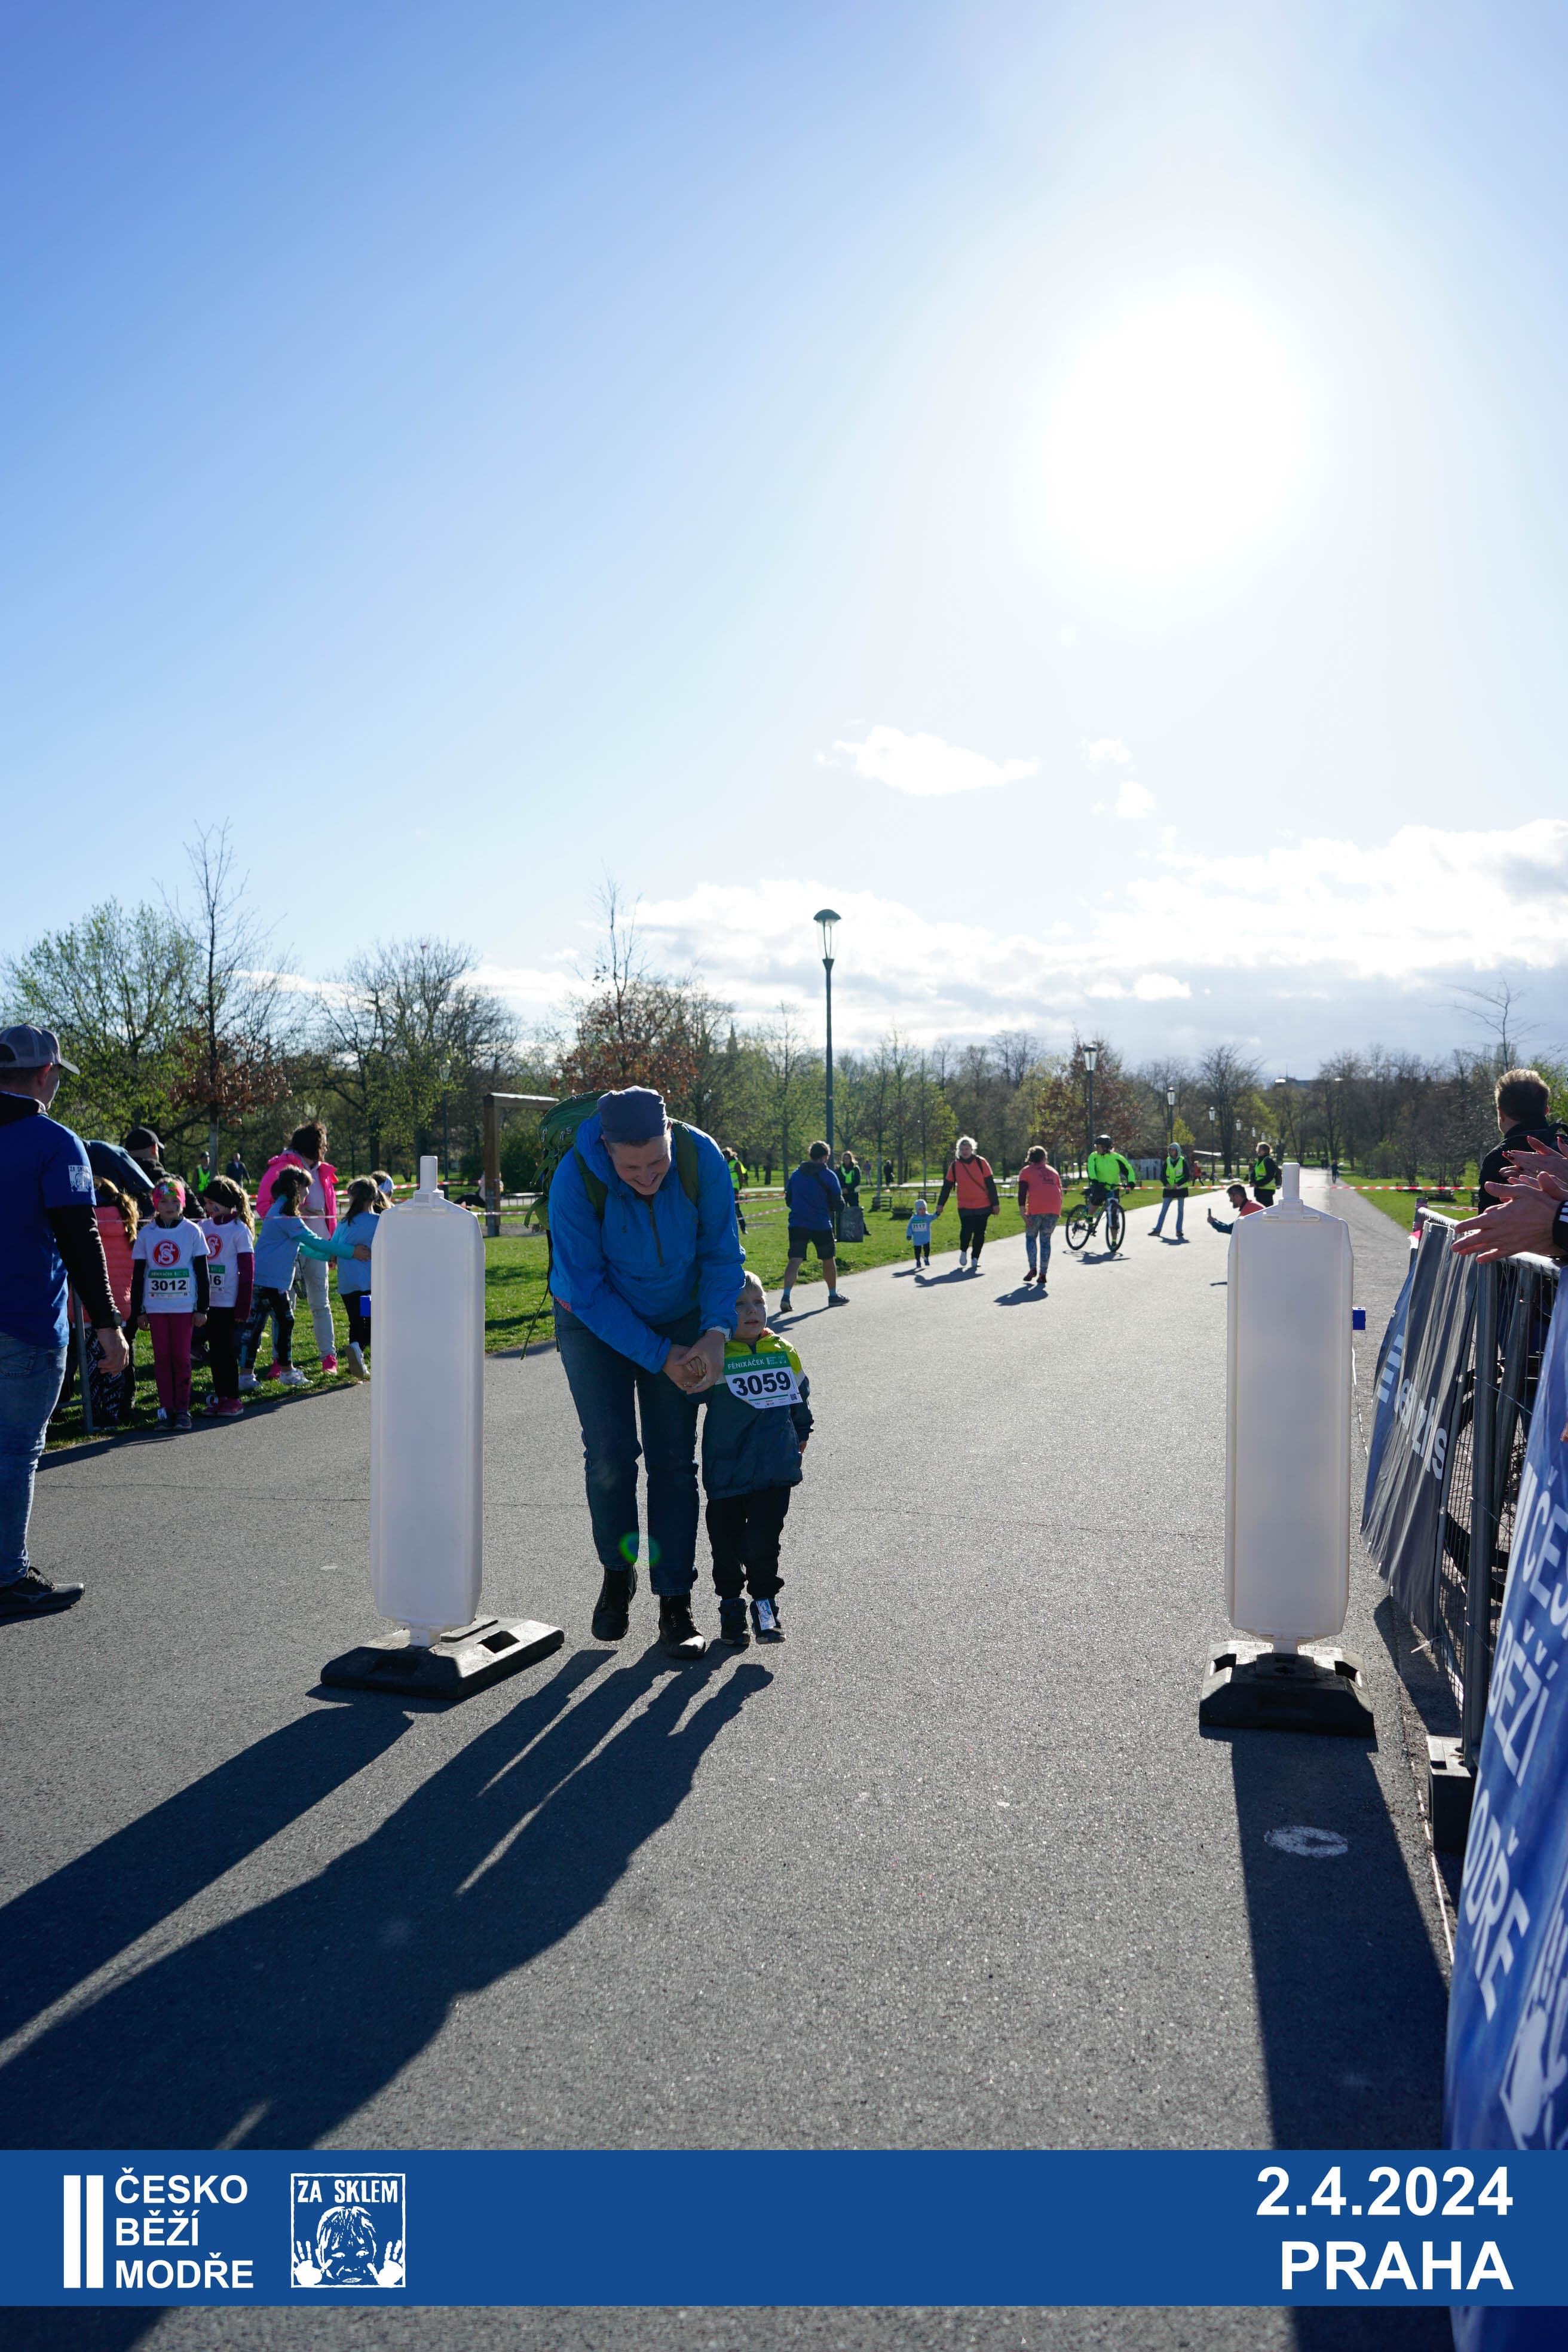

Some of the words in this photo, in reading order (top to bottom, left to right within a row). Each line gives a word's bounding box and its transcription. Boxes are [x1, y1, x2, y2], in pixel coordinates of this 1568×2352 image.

[151, 1279, 186, 1291] 3012
[727, 1358, 765, 1370] FÉNIXÁČEK
[732, 1371, 791, 1396] 3059
[1487, 1618, 1559, 1788] BĚŽÍ
[1462, 1788, 1530, 2023] ODŘE
